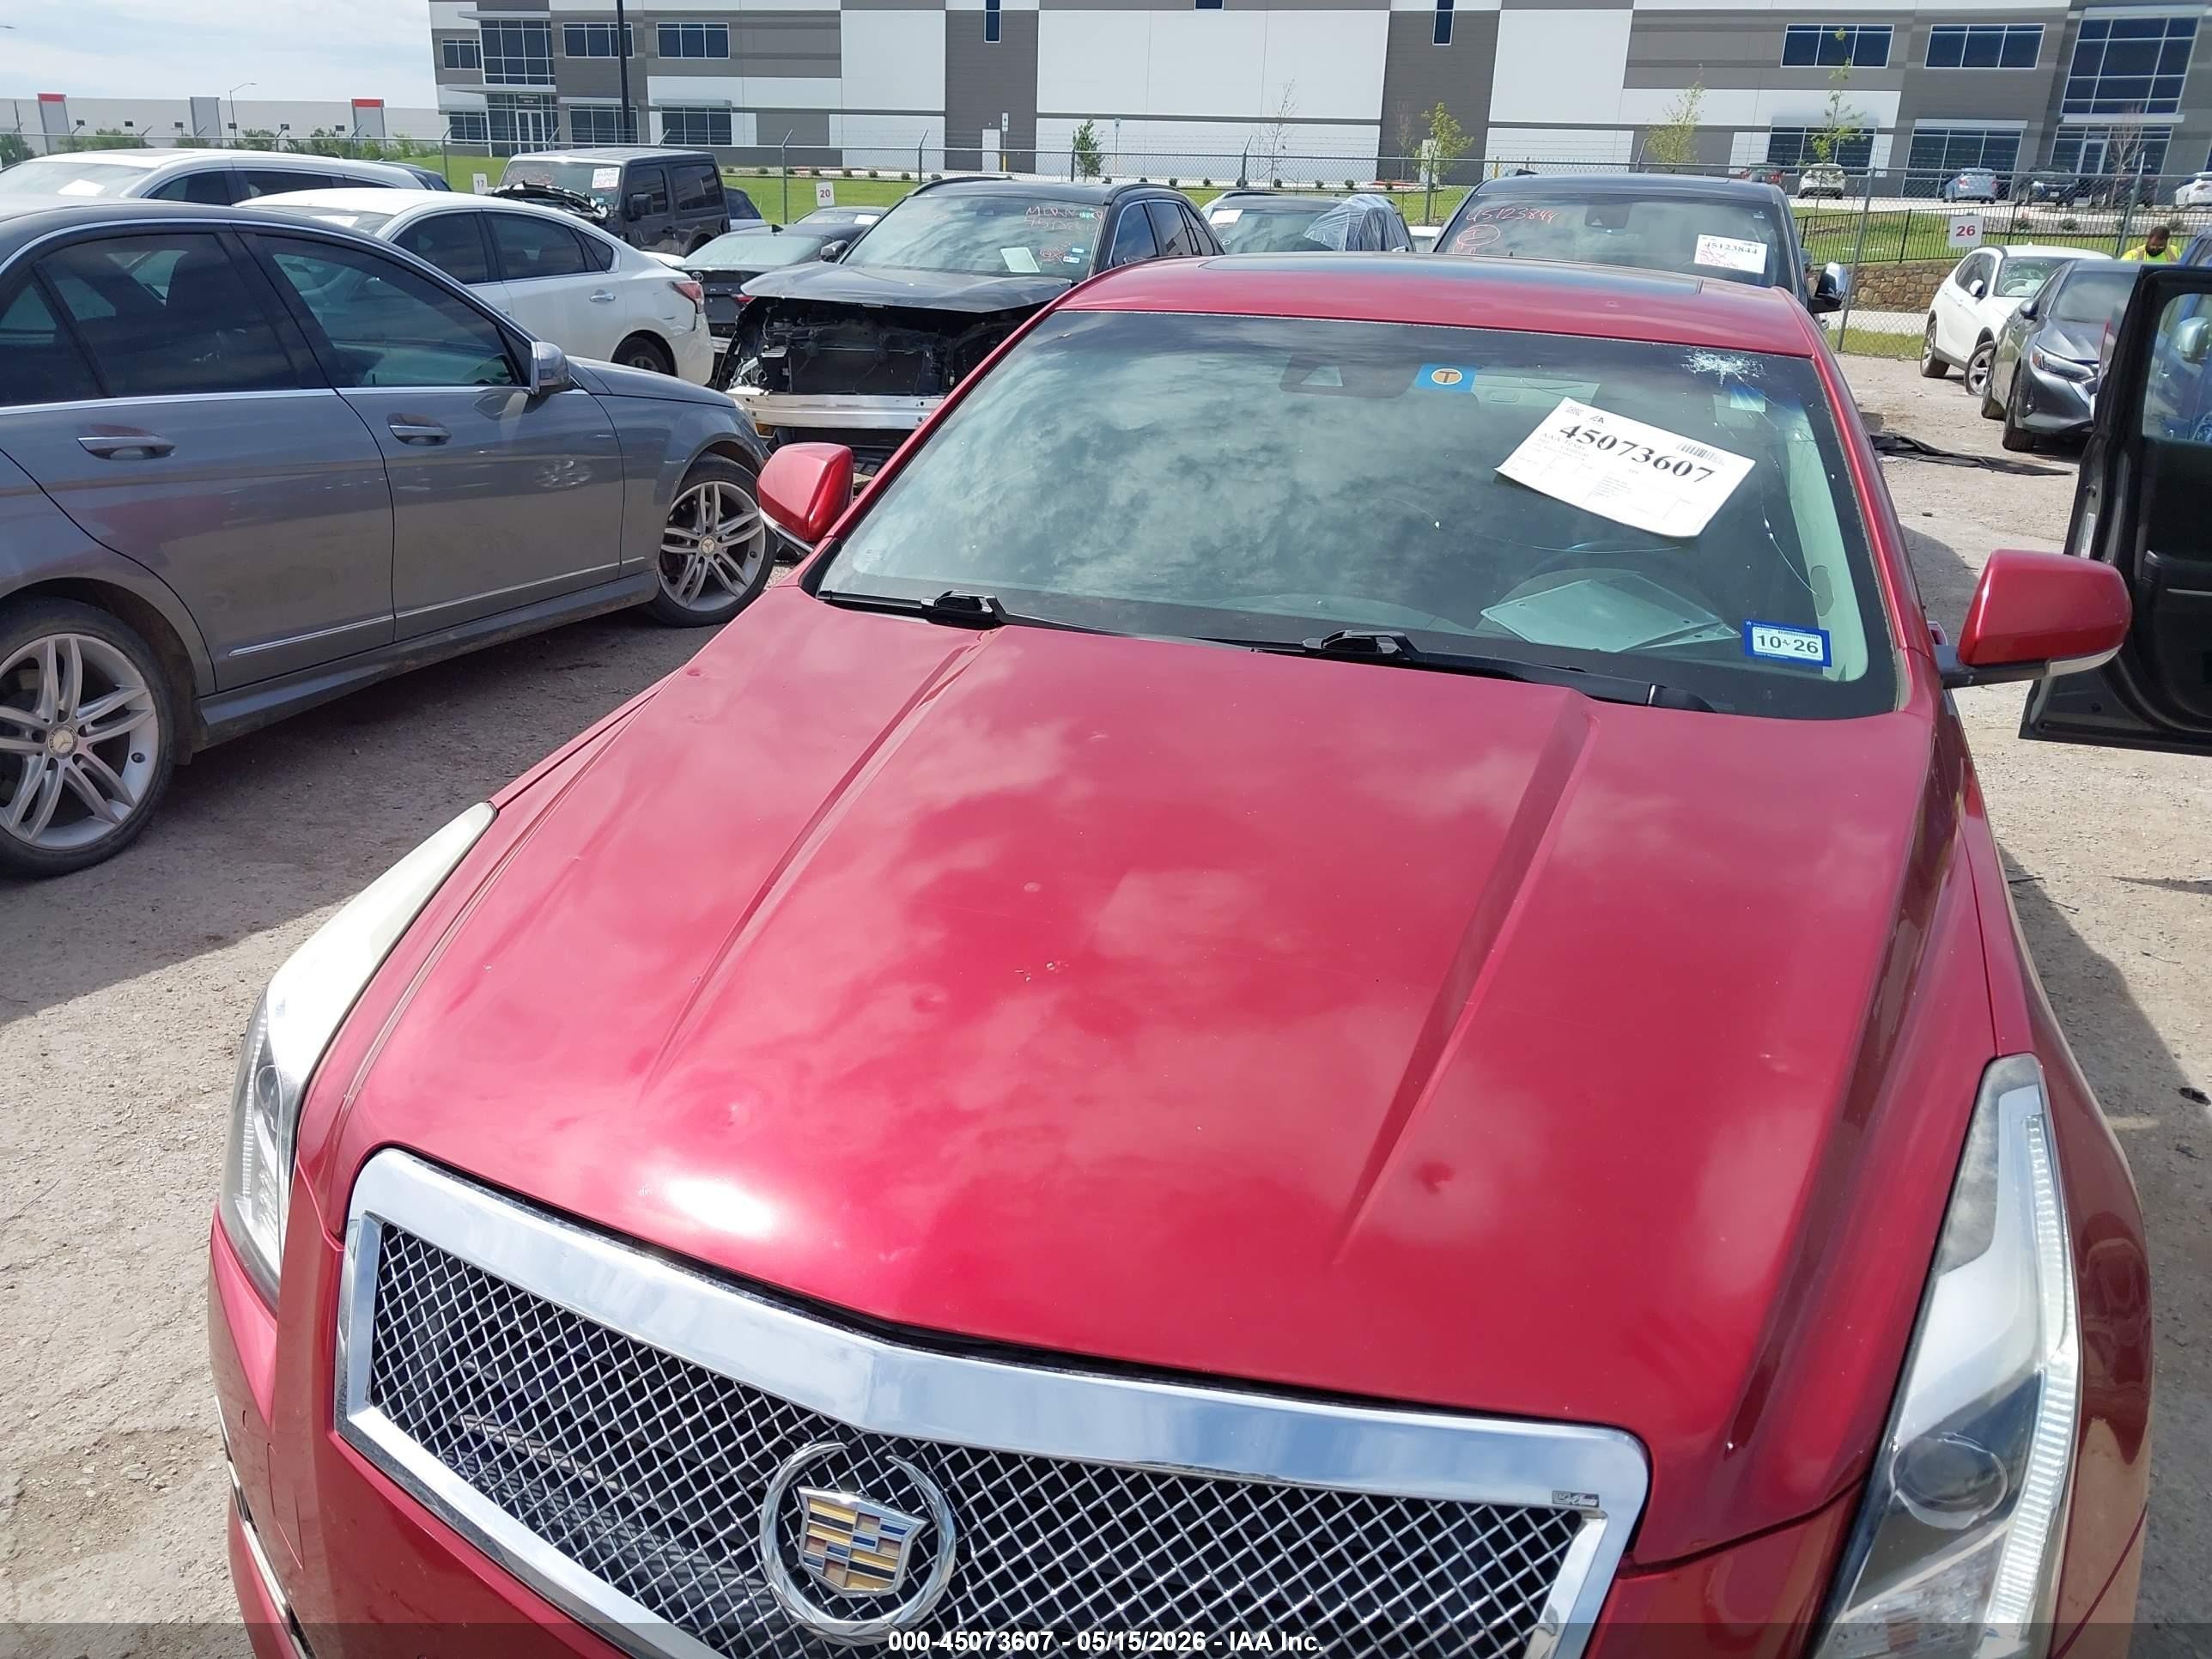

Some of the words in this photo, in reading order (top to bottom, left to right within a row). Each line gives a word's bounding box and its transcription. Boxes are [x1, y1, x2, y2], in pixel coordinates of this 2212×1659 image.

[819, 189, 830, 198] 20
[1956, 225, 1976, 237] 26
[1704, 242, 1758, 254] 45123844
[1439, 370, 1458, 383] T
[1559, 425, 1716, 483] 45073607
[1757, 635, 1782, 648] 10
[1794, 639, 1819, 653] 26
